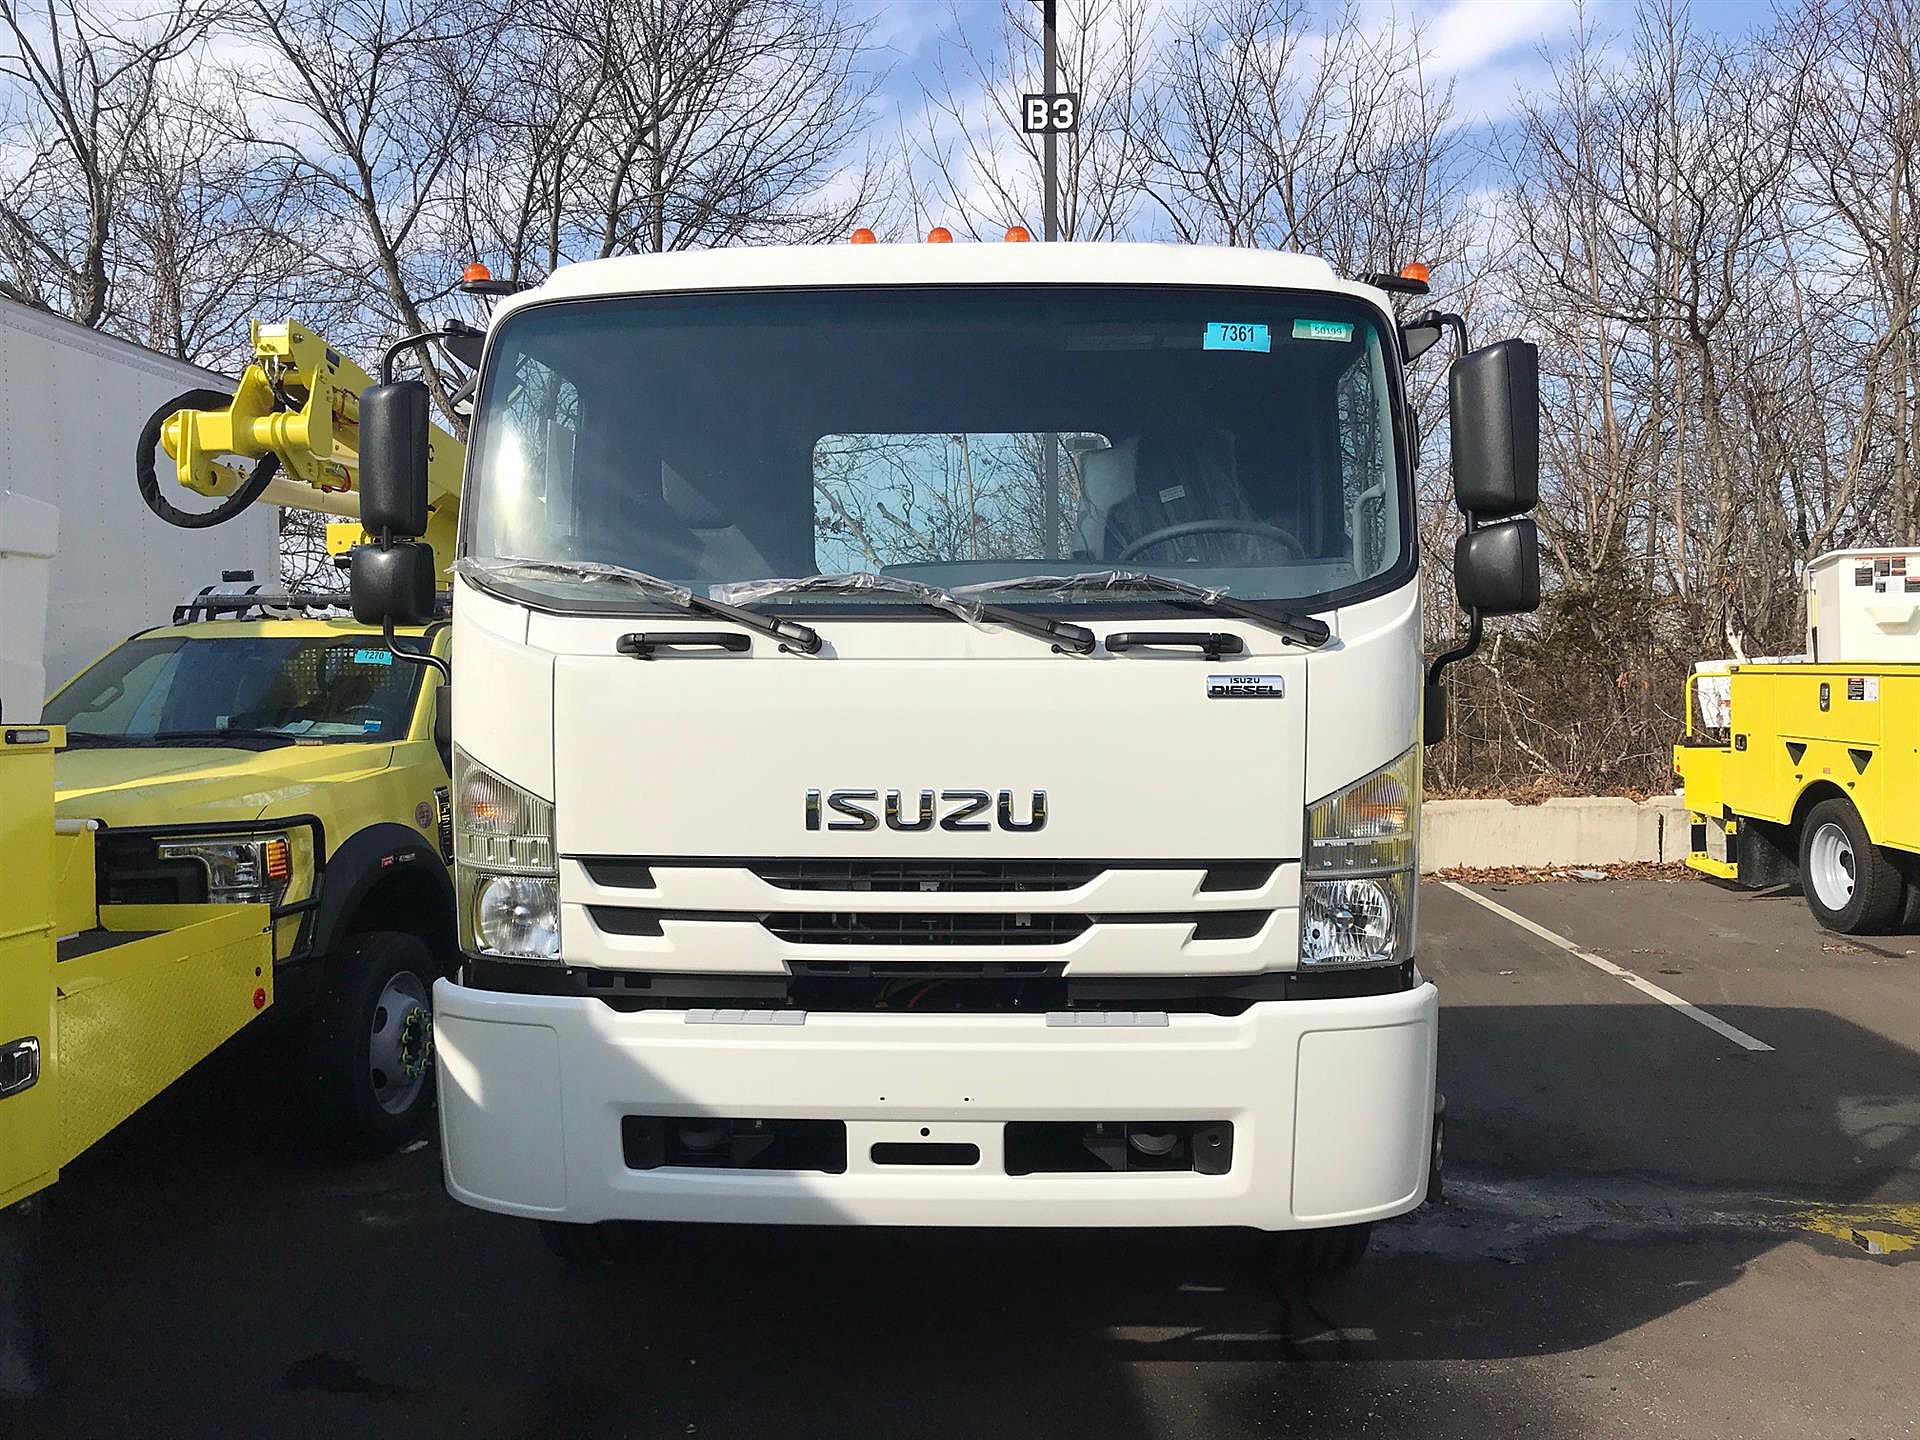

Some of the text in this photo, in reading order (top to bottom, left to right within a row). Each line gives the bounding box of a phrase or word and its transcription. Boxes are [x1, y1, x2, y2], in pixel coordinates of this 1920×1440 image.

[1027, 98, 1074, 130] B3
[1220, 325, 1255, 342] 7361
[364, 651, 385, 660] 7270
[1208, 685, 1282, 695] DIESEL
[806, 789, 1048, 831] ISUZU
